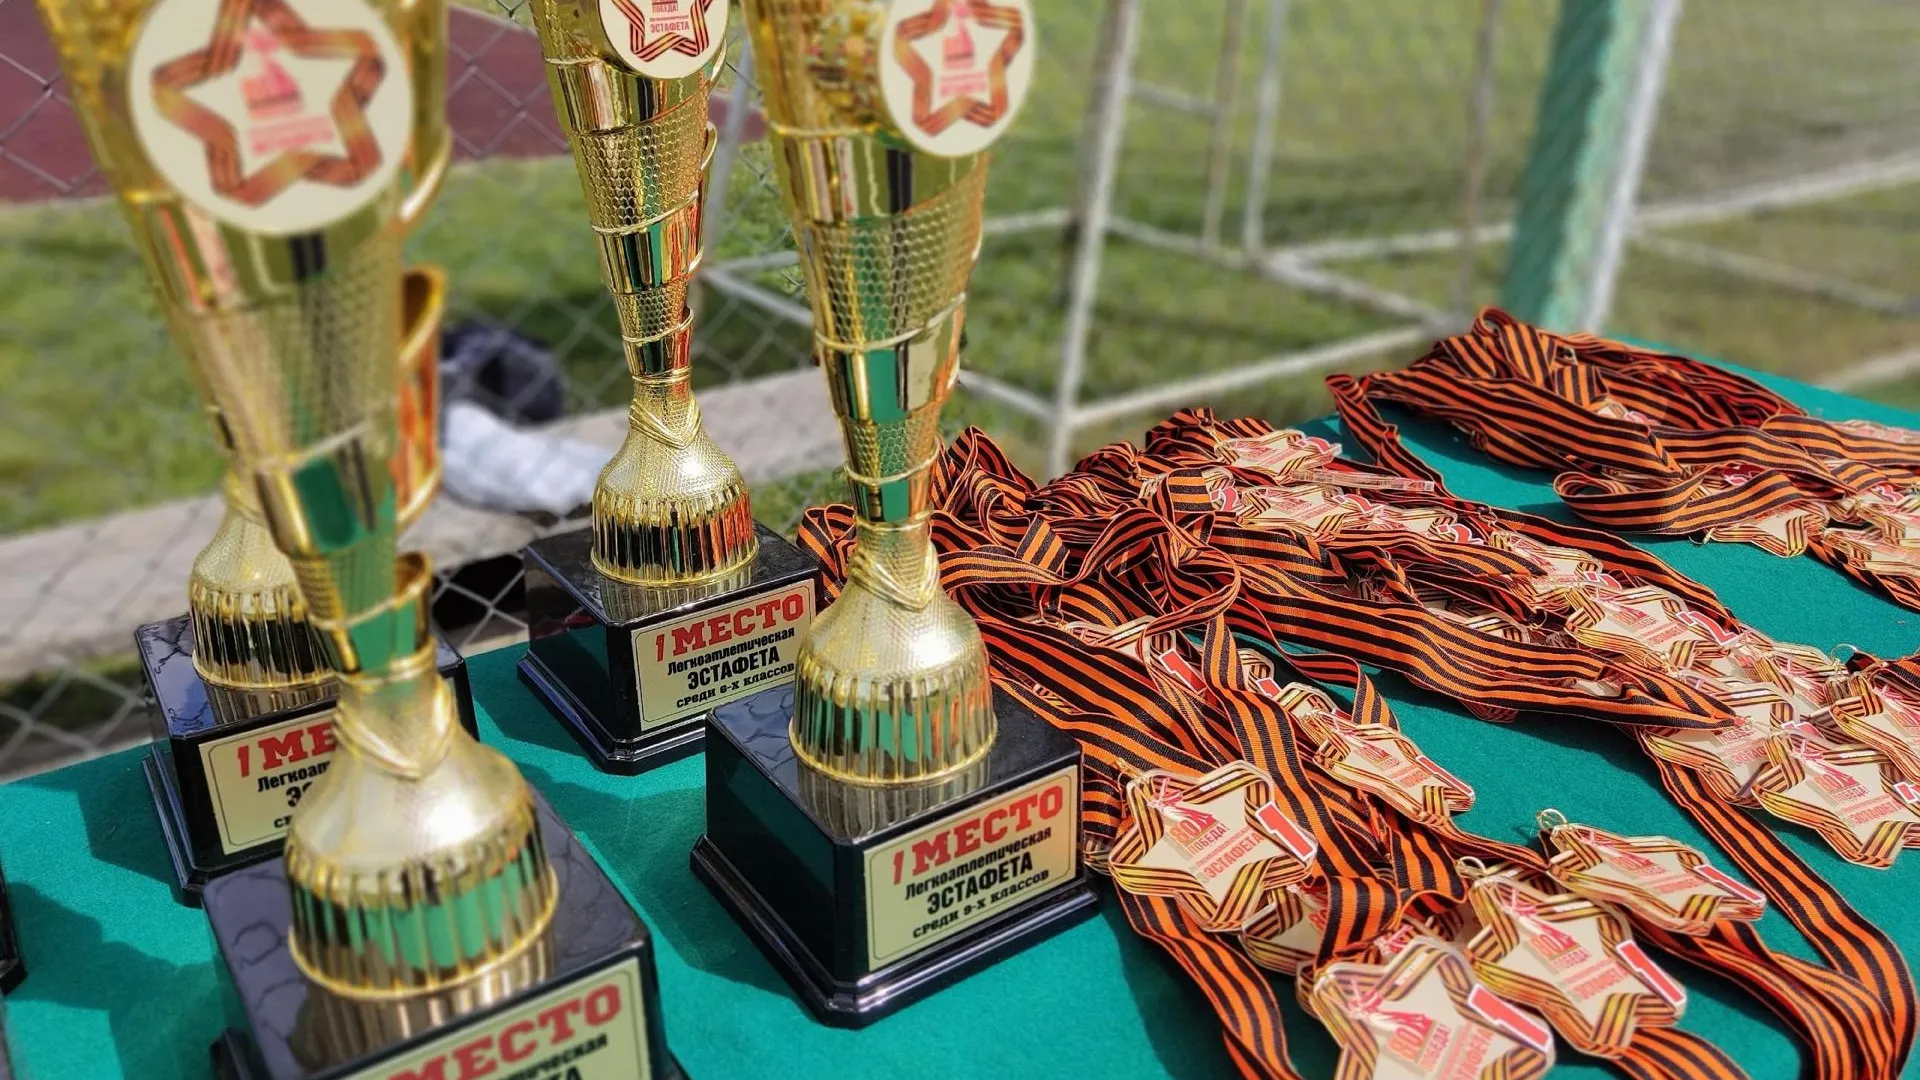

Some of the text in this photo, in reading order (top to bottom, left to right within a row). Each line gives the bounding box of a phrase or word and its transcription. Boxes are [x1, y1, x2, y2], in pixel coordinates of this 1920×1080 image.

[650, 21, 690, 33] ЭСТАФЕТА
[655, 593, 805, 662] 1 МЕСТО
[667, 627, 795, 676] Легкоатлетическая
[1676, 611, 1740, 645] 2
[676, 687, 717, 708] среди
[743, 663, 795, 687] классов
[687, 646, 780, 690] ЭСТАФЕТА
[237, 745, 250, 778] 1
[1416, 755, 1475, 796] 1
[893, 785, 1063, 885] 1 МЕСТО
[1188, 822, 1230, 856] ПОБЕДА!
[1256, 801, 1317, 861] 1
[905, 827, 1052, 900] Легкоатлетическая
[1203, 832, 1265, 879] ЭСТАФЕТА
[912, 910, 960, 938] среди
[990, 869, 1049, 904] классов
[927, 852, 1033, 915] ЭСТАФЕТА
[1694, 864, 1765, 904] 1
[1617, 940, 1686, 1004] 1
[1468, 984, 1551, 1052] 1
